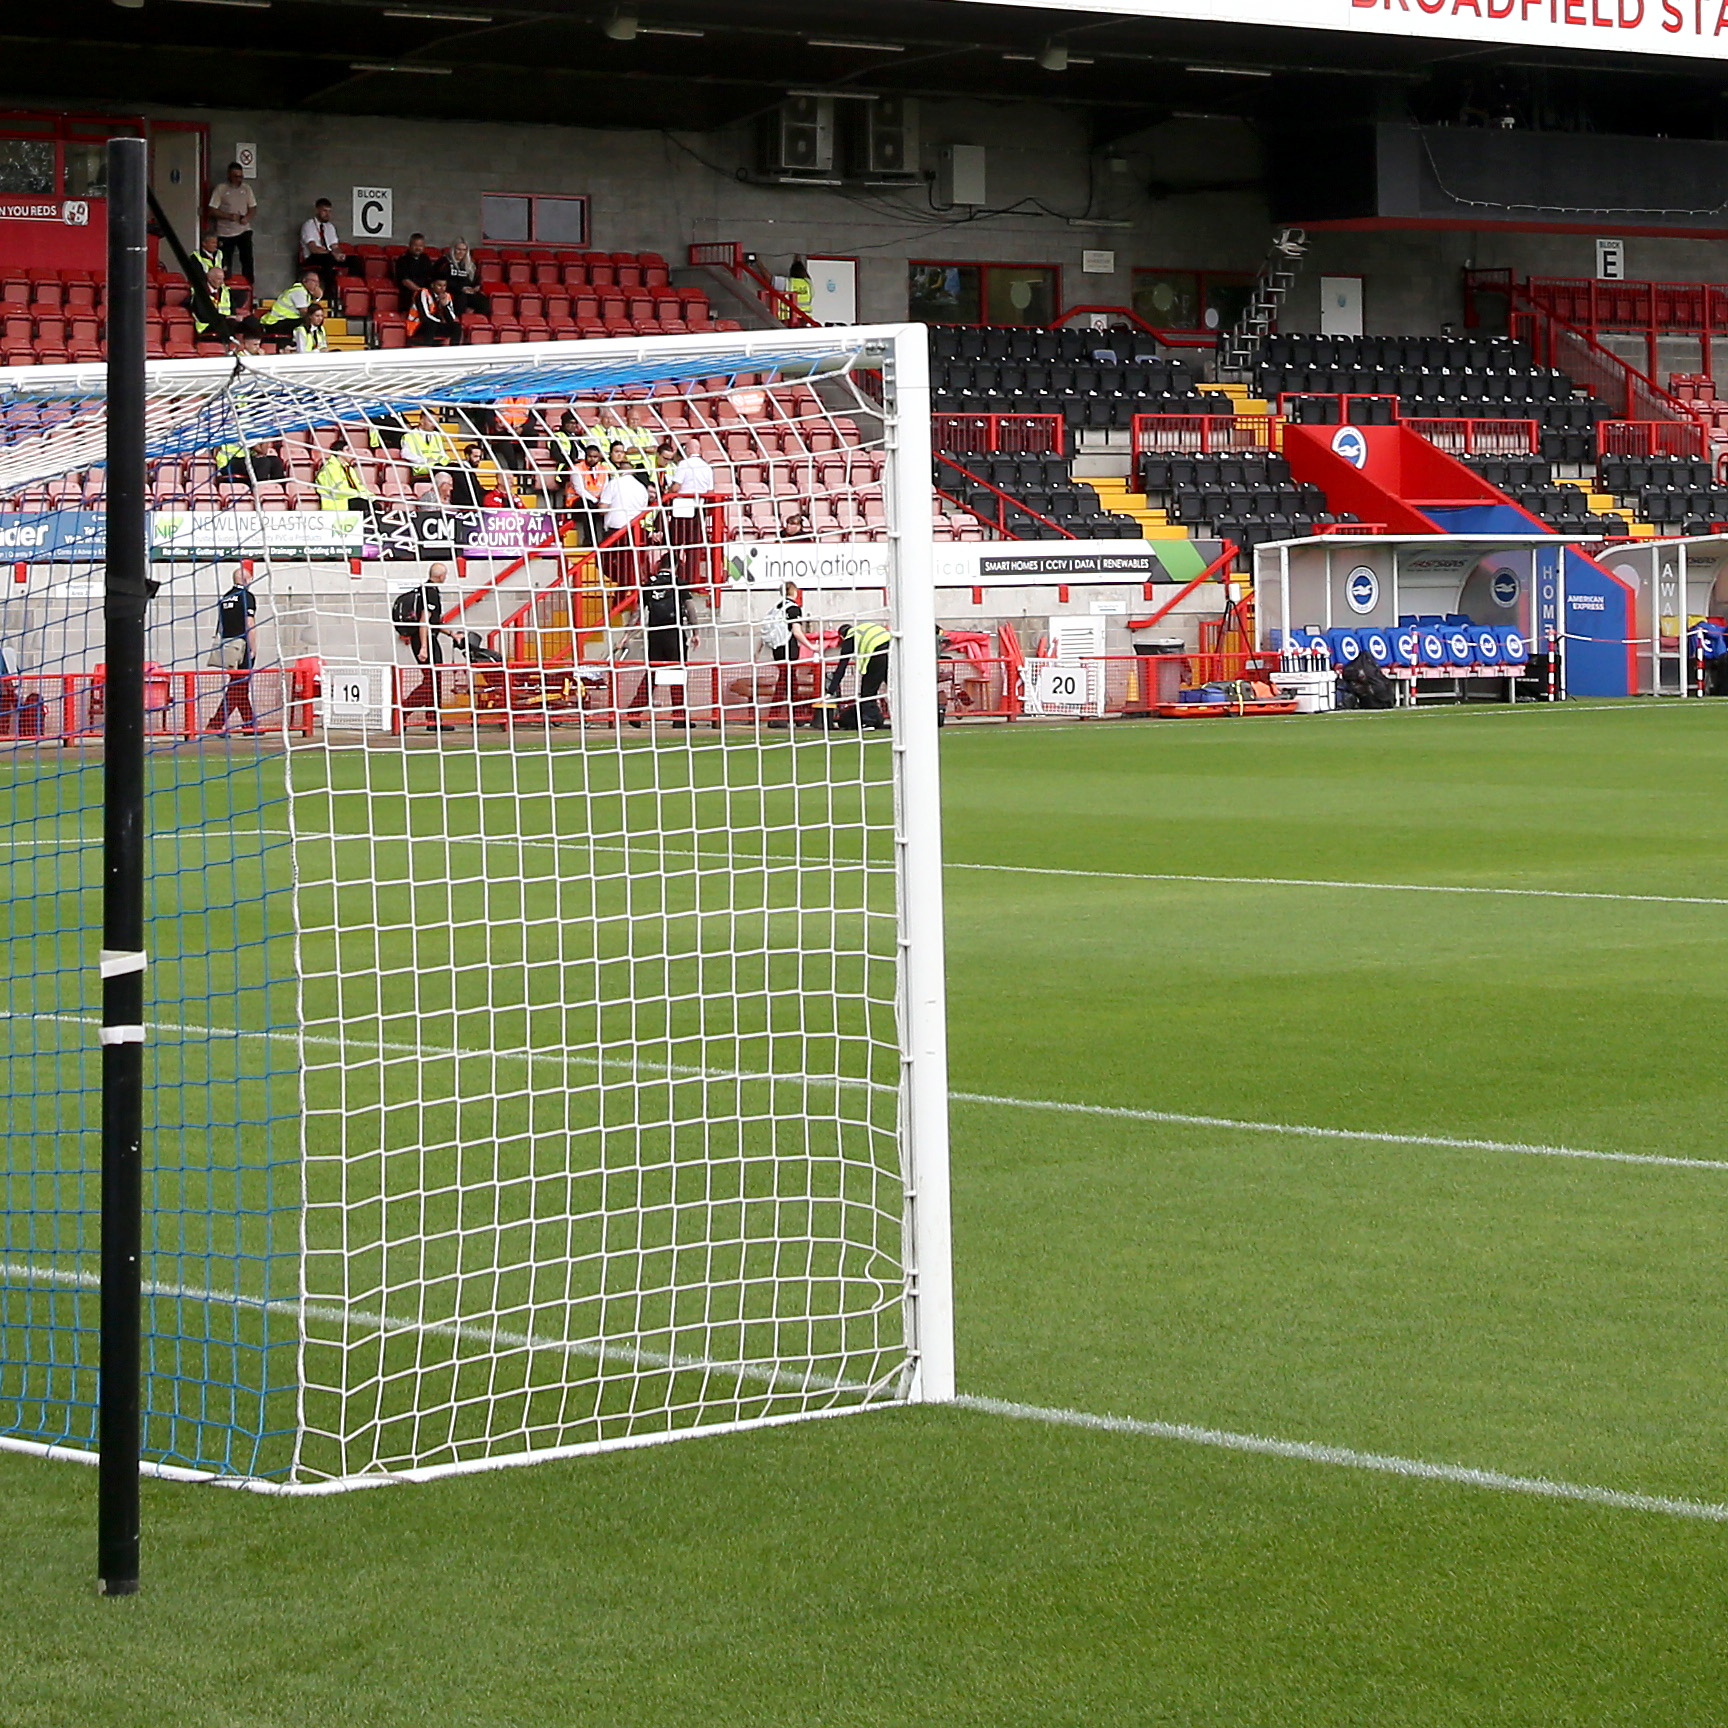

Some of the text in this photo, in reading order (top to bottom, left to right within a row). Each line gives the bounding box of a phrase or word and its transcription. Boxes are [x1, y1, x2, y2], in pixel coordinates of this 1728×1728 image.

[357, 189, 387, 198] BLOCK
[7, 206, 29, 216] YOU
[30, 205, 57, 216] REDS
[361, 200, 384, 234] C
[1603, 250, 1617, 278] E
[193, 516, 324, 531] NEWLINE PLASTICS
[422, 518, 455, 539] CM
[488, 517, 544, 530] SHOP AT
[469, 532, 523, 546] COUNTY
[765, 554, 871, 577] innovation
[984, 558, 1149, 571] SMART HOMES CCTV DATA RENEWABLES
[1661, 563, 1675, 635] AWAY
[343, 684, 360, 702] 19
[1052, 676, 1075, 695] 20
